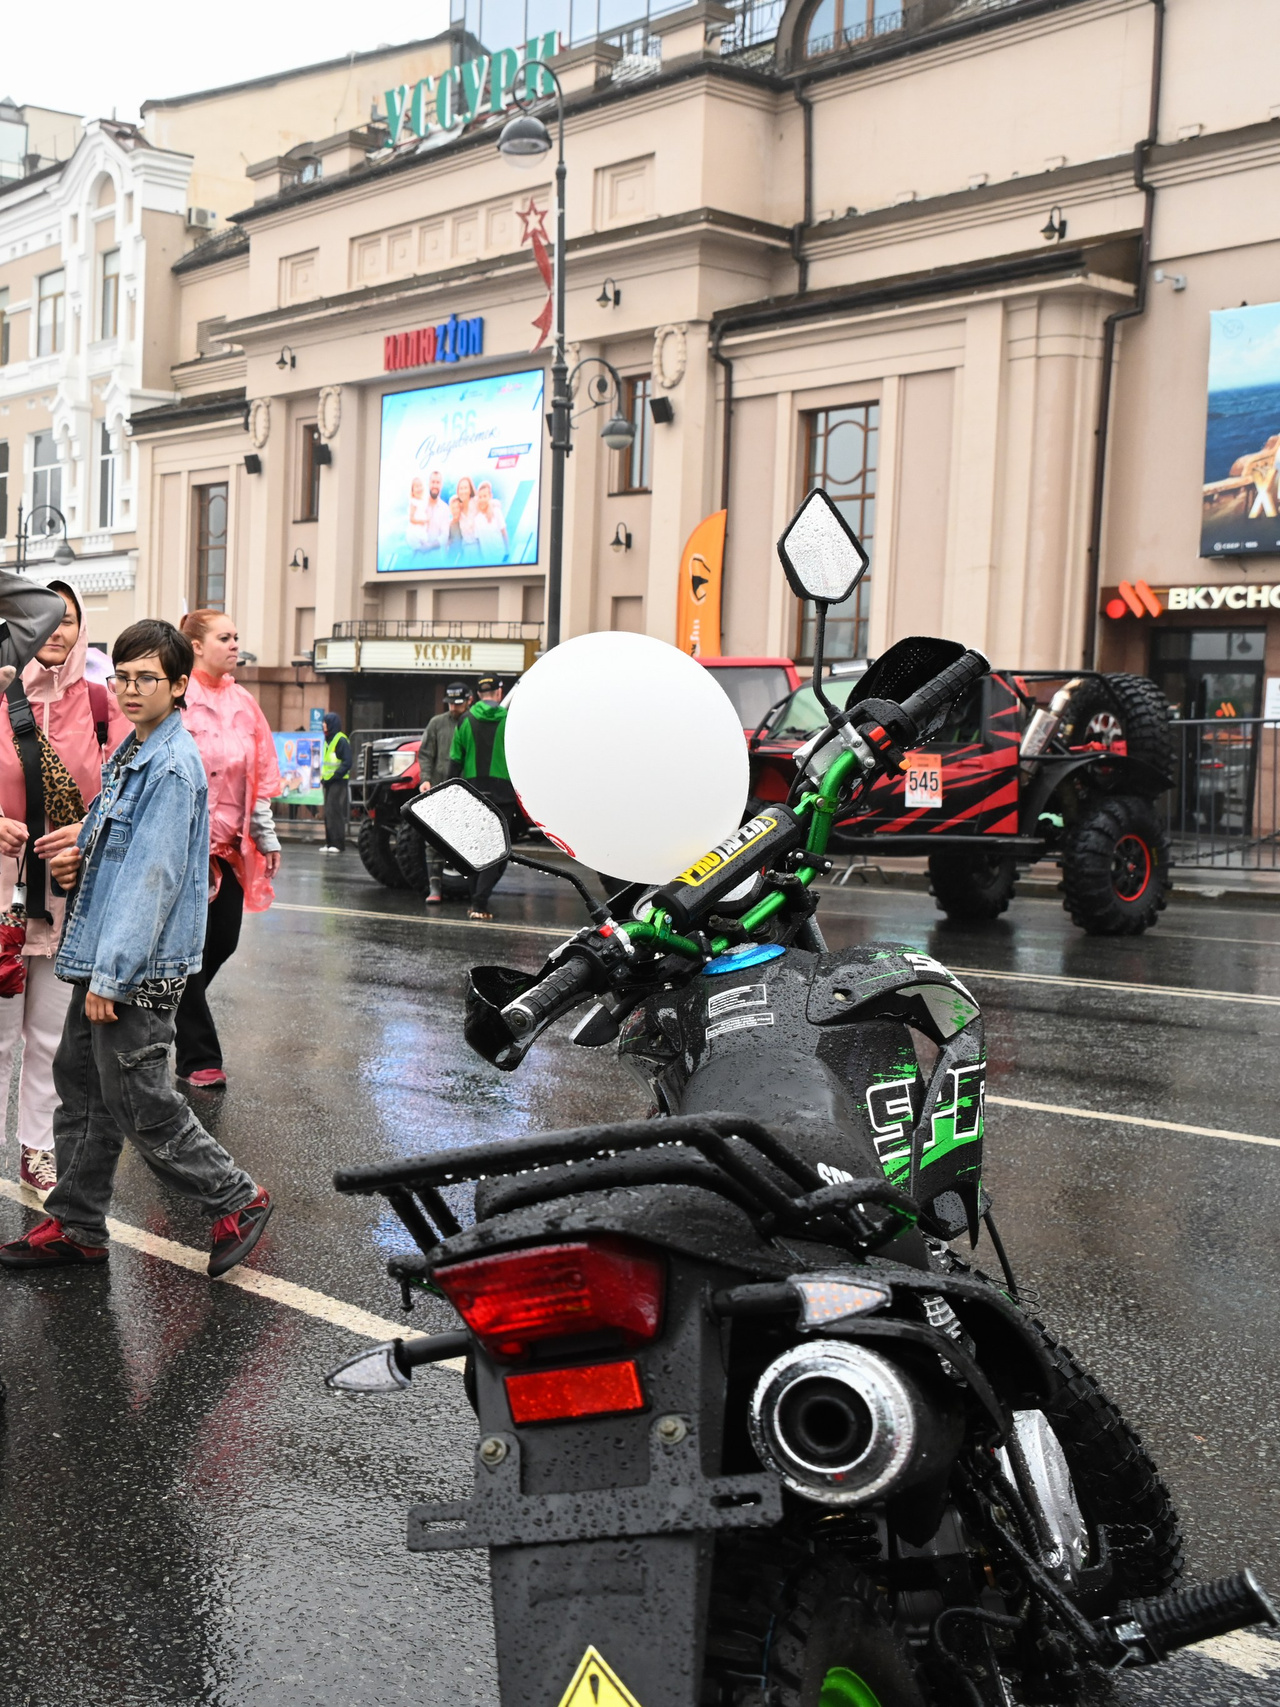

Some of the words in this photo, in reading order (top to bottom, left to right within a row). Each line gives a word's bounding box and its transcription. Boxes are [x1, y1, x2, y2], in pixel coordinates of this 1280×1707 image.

[384, 30, 561, 149] УССУРИ
[414, 643, 472, 662] УССУРИ
[909, 770, 939, 791] 545
